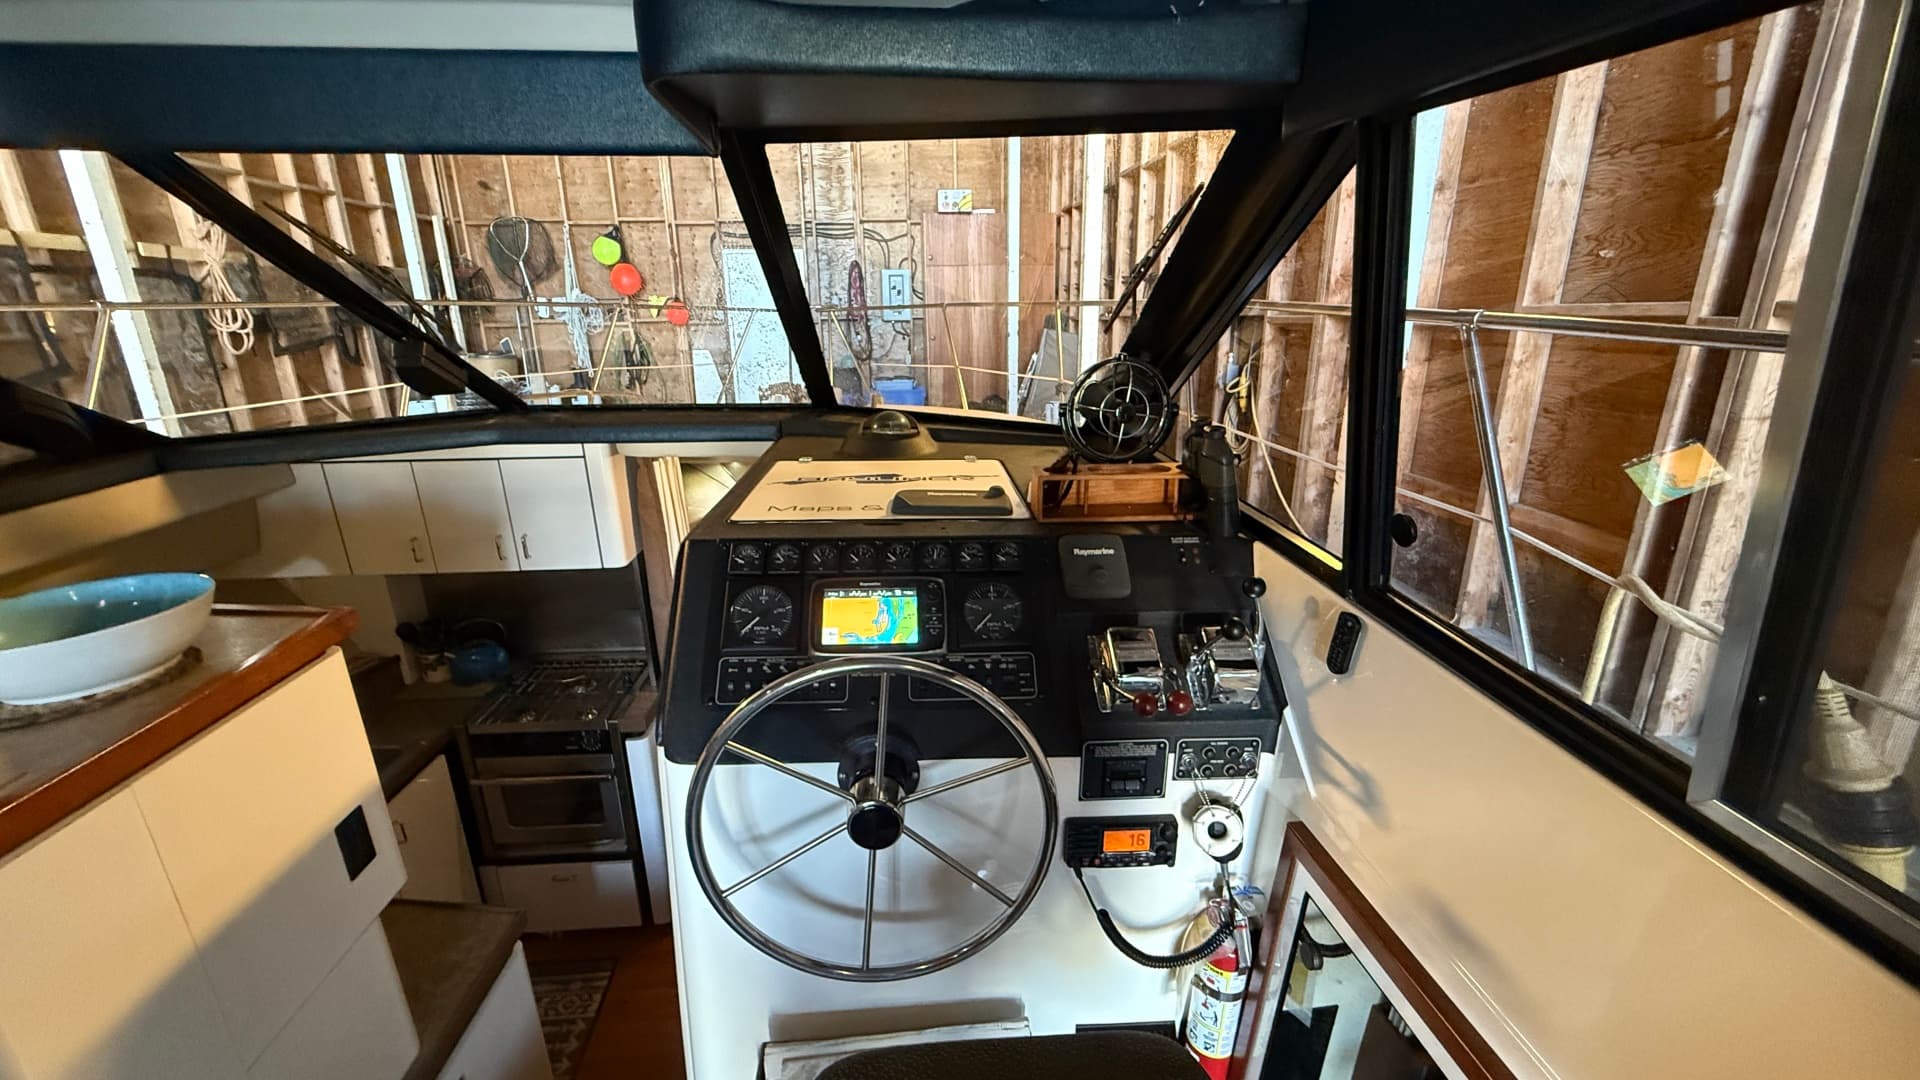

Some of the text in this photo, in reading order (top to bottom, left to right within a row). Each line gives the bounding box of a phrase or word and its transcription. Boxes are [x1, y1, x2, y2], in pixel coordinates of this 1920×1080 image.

[767, 504, 853, 513] Maps
[1073, 547, 1115, 557] Raymarine
[1129, 833, 1145, 847] 16
